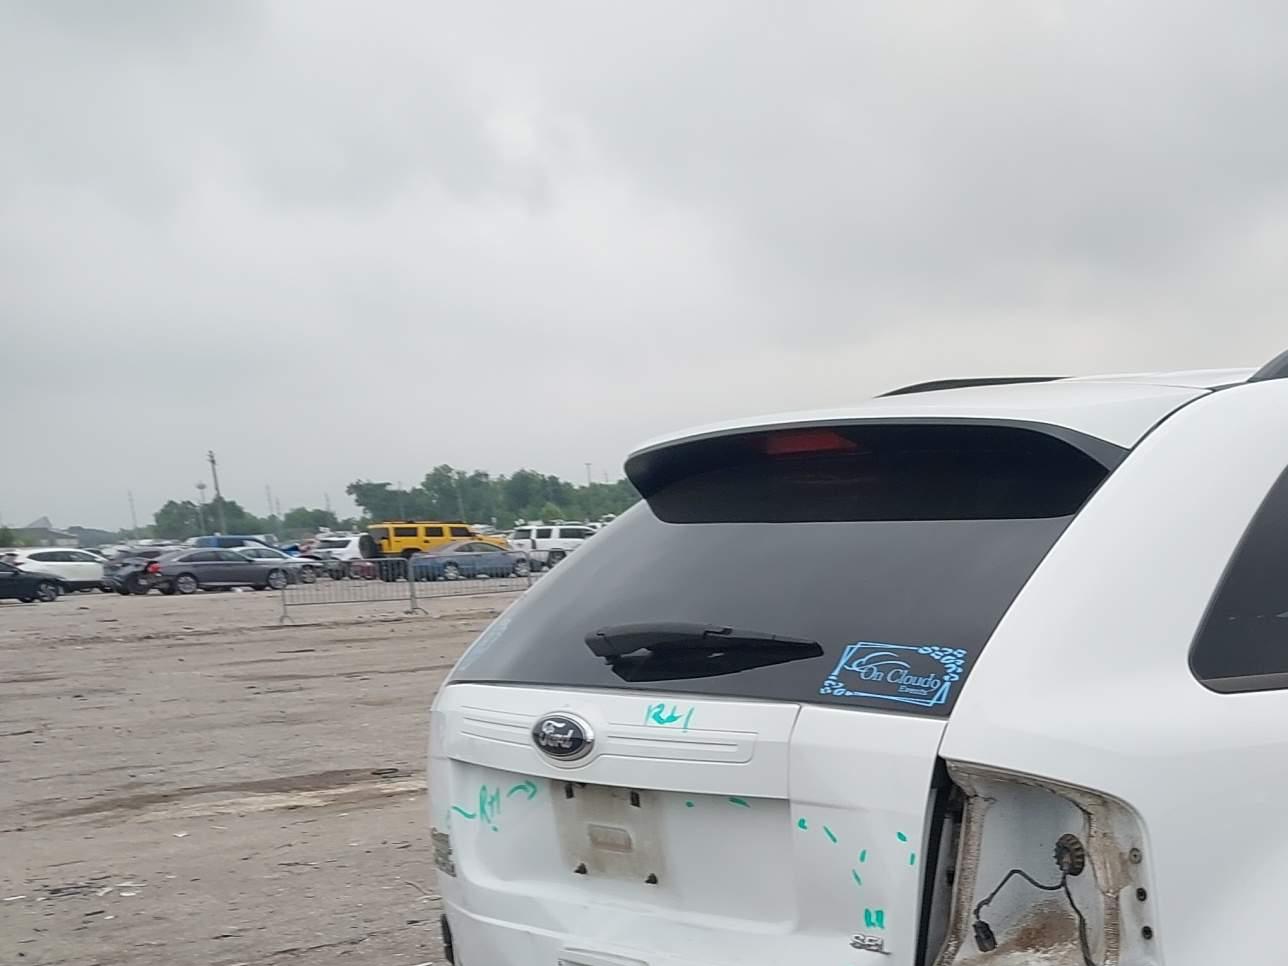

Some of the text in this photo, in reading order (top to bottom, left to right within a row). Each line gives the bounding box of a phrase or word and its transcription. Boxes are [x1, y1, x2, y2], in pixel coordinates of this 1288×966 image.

[860, 665, 884, 681] On
[539, 720, 575, 748] Ford
[848, 934, 892, 955] SEL
